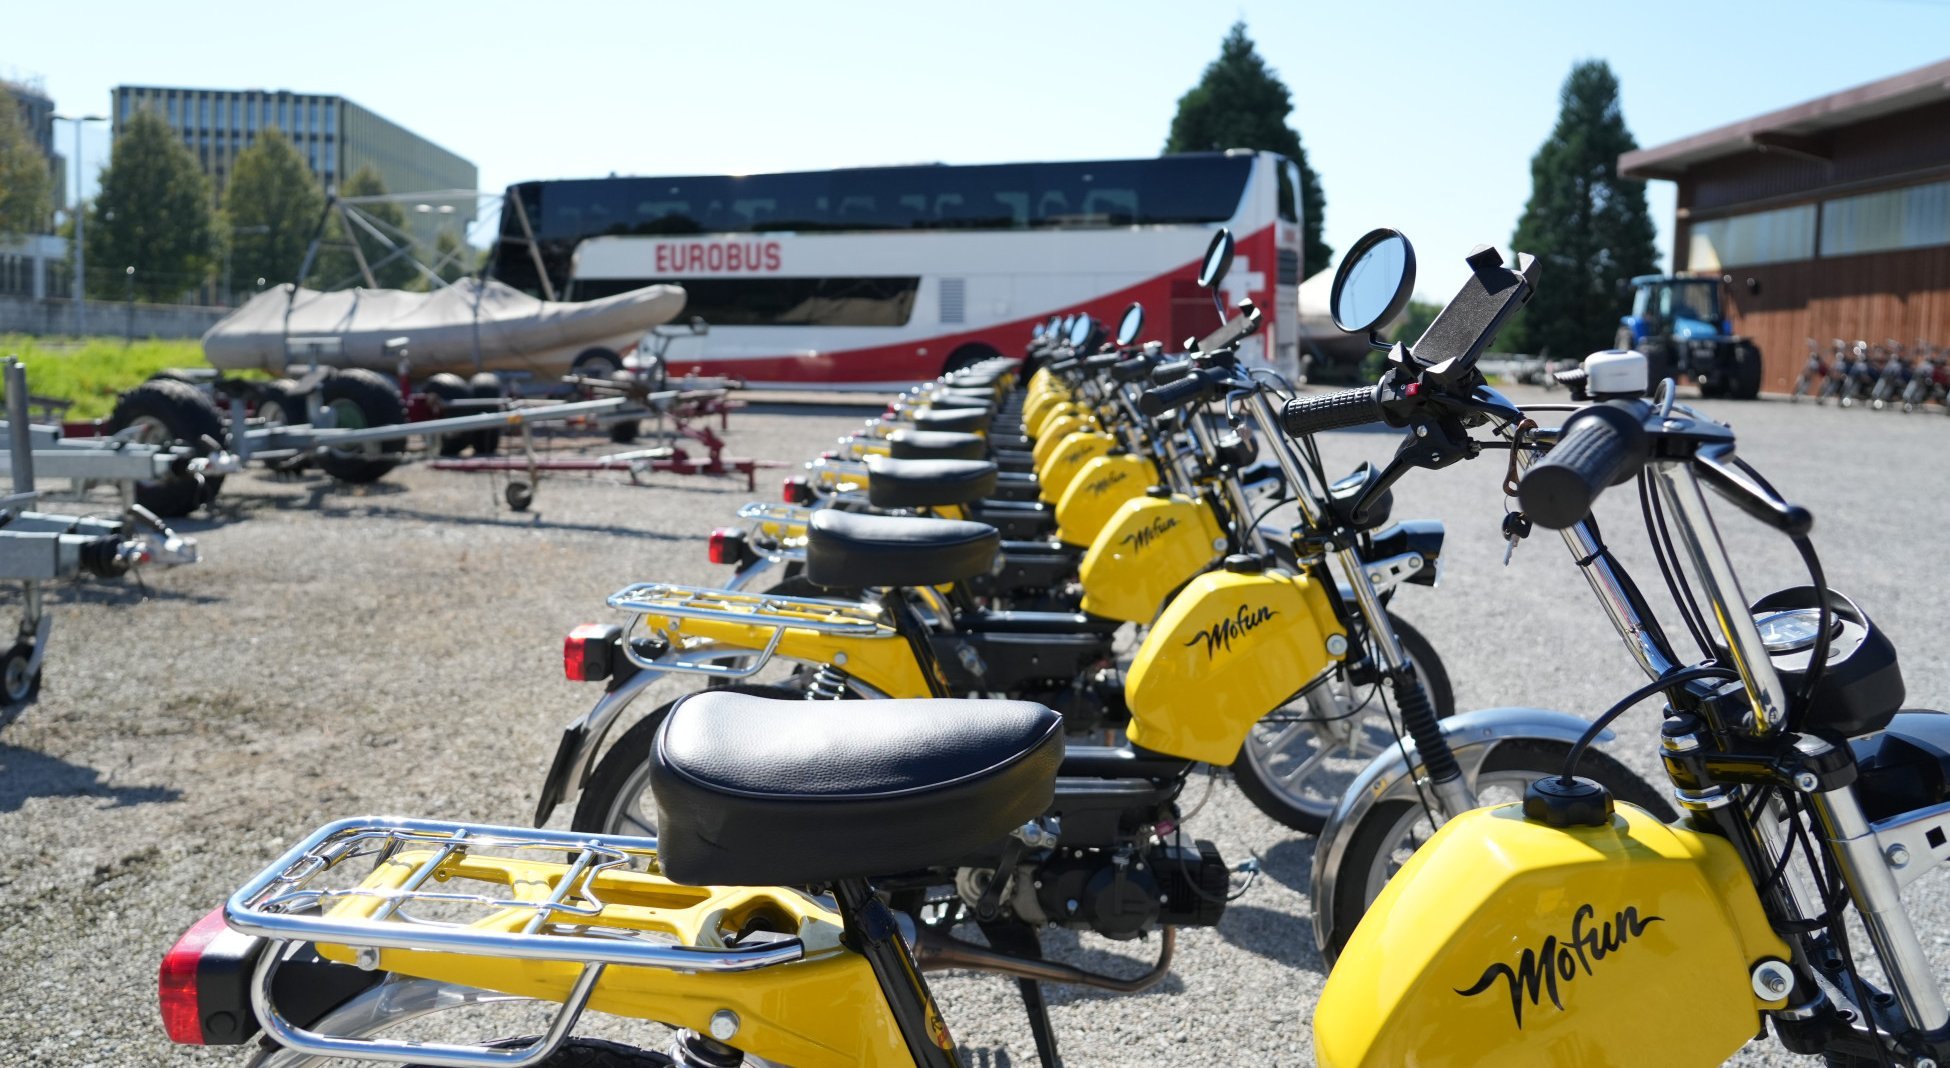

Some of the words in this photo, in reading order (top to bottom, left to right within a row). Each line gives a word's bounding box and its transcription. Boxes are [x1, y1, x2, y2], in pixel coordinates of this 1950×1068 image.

[655, 242, 781, 272] EUROBUS
[1119, 515, 1180, 554] Mofun
[1183, 603, 1280, 662] Mofun
[1452, 903, 1665, 1030] Mofun
